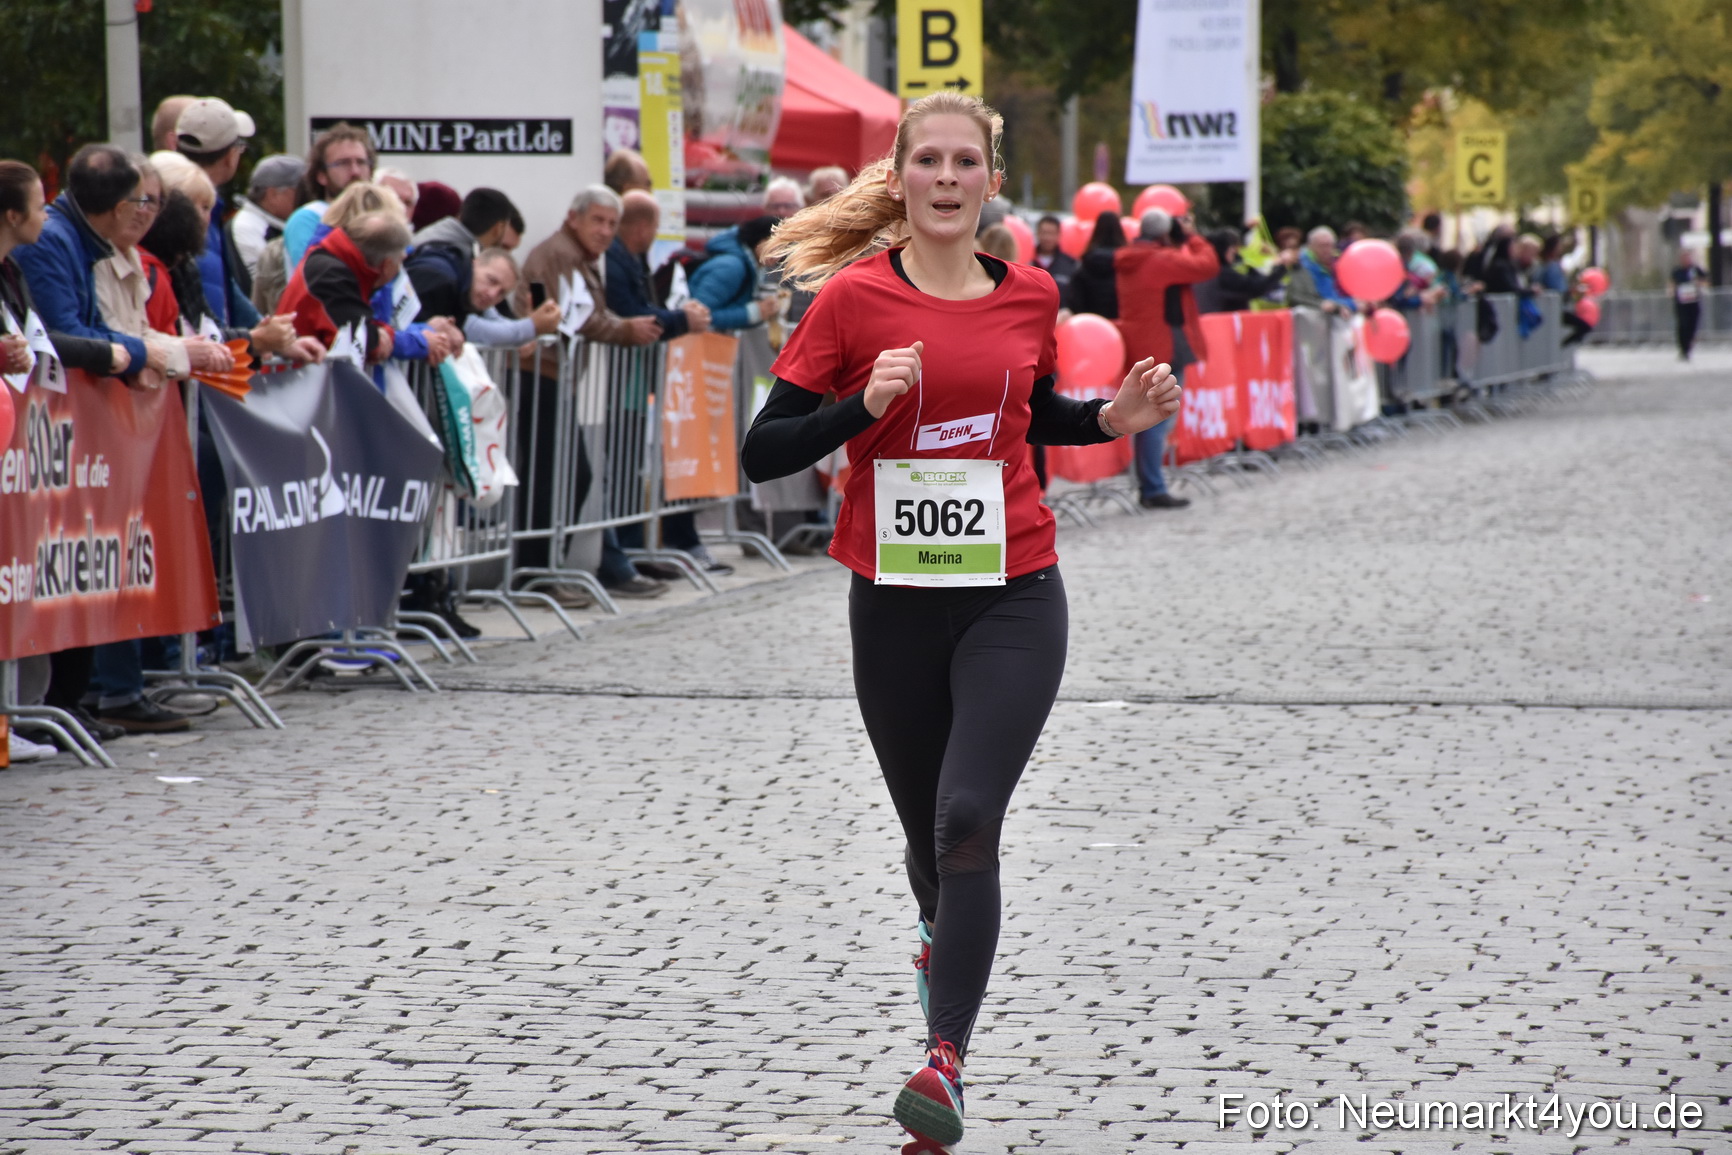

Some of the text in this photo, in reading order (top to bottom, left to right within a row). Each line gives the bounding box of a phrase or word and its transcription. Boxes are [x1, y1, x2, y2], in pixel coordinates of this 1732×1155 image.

[920, 10, 960, 68] B
[1468, 153, 1491, 187] C
[1578, 190, 1597, 213] D
[939, 424, 973, 441] DEHN
[923, 471, 967, 482] BOCK
[894, 499, 986, 537] 5062
[881, 530, 888, 539] S
[918, 551, 962, 565] Marina
